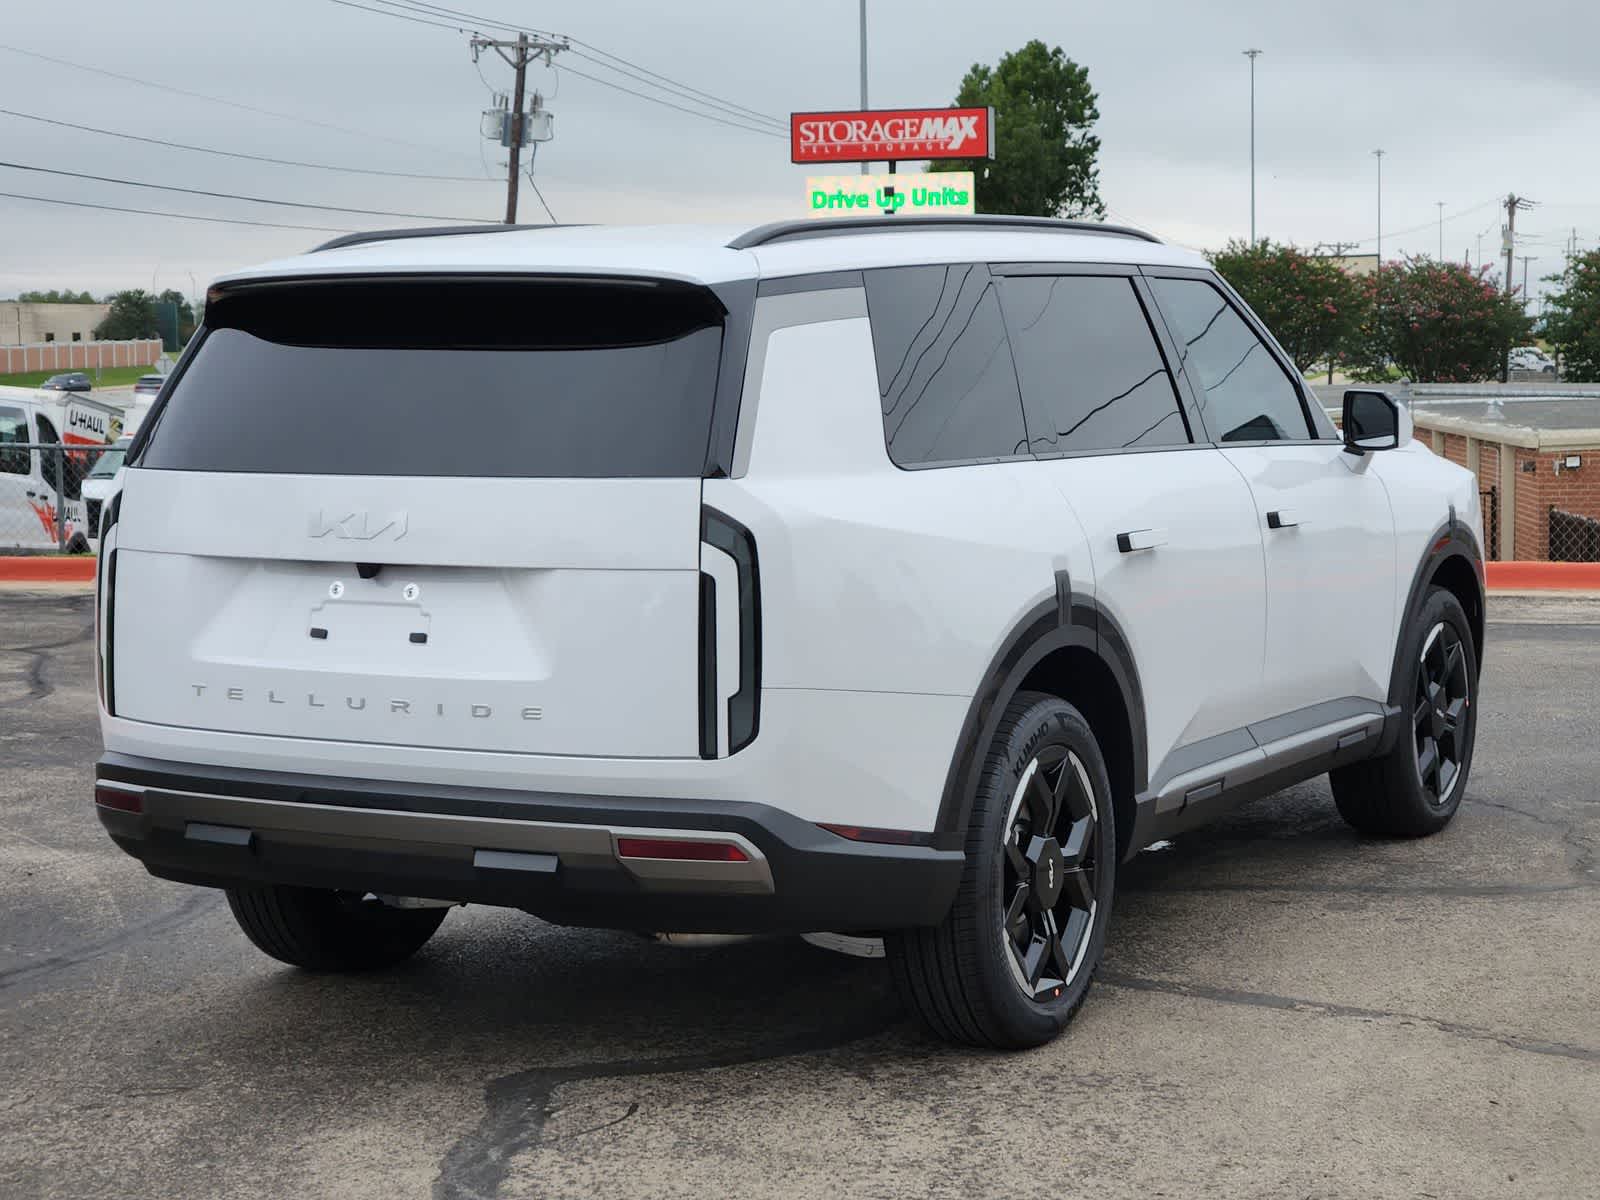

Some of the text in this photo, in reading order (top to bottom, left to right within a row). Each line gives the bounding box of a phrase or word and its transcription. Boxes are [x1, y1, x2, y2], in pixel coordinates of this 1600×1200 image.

[862, 139, 945, 153] STORAGE
[812, 187, 969, 211] Drive Up Units
[191, 683, 543, 721] TELLURIDE
[1013, 721, 1049, 779] KUMHO
